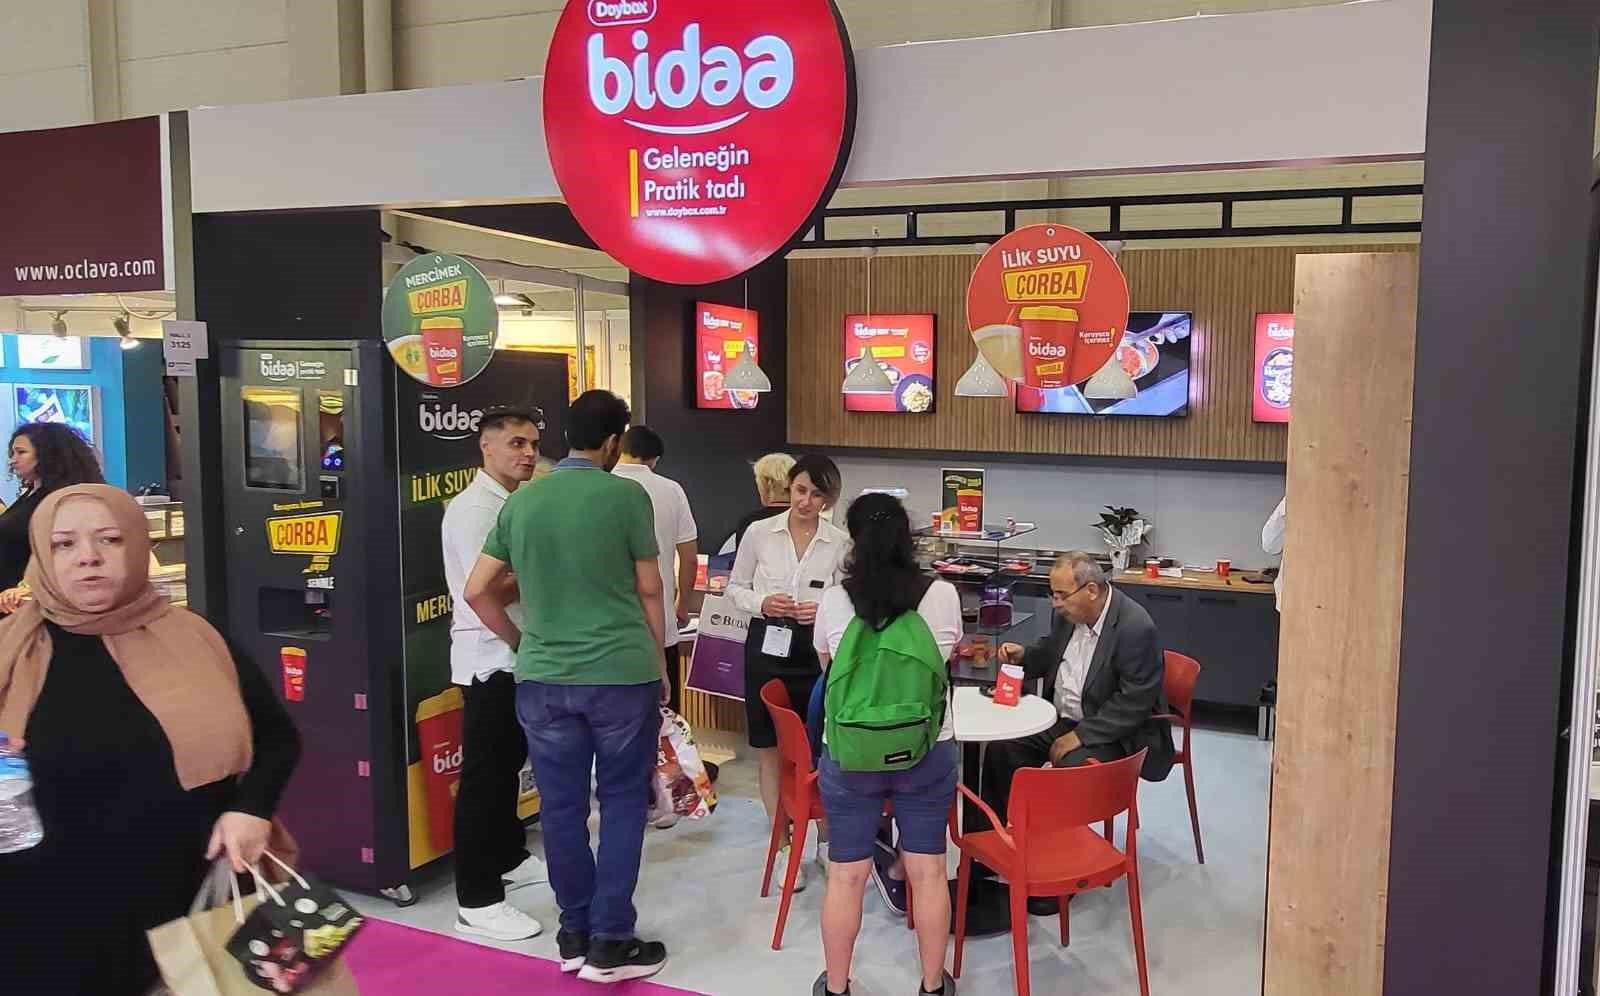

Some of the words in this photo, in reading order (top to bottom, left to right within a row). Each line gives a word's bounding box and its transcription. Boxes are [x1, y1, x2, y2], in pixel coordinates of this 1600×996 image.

[595, 0, 649, 20] Doybox
[586, 22, 794, 116] bidaa
[643, 143, 749, 172] Geleneğin
[643, 179, 700, 202] Pratik
[705, 176, 745, 200] tadı
[645, 205, 727, 218] www.doybox.com.tr
[1001, 248, 1034, 268] İLİK
[1036, 245, 1081, 261] SUYU
[15, 258, 156, 281] www.oclava.com
[405, 264, 462, 288] MERCİMEK
[1016, 270, 1079, 299] ÇORBA
[170, 341, 193, 350] 3125
[1028, 342, 1067, 358] bidaa
[260, 359, 296, 378] bidaa
[418, 403, 483, 433] bidaa
[411, 472, 442, 502] İLİK
[444, 467, 477, 494] SUY
